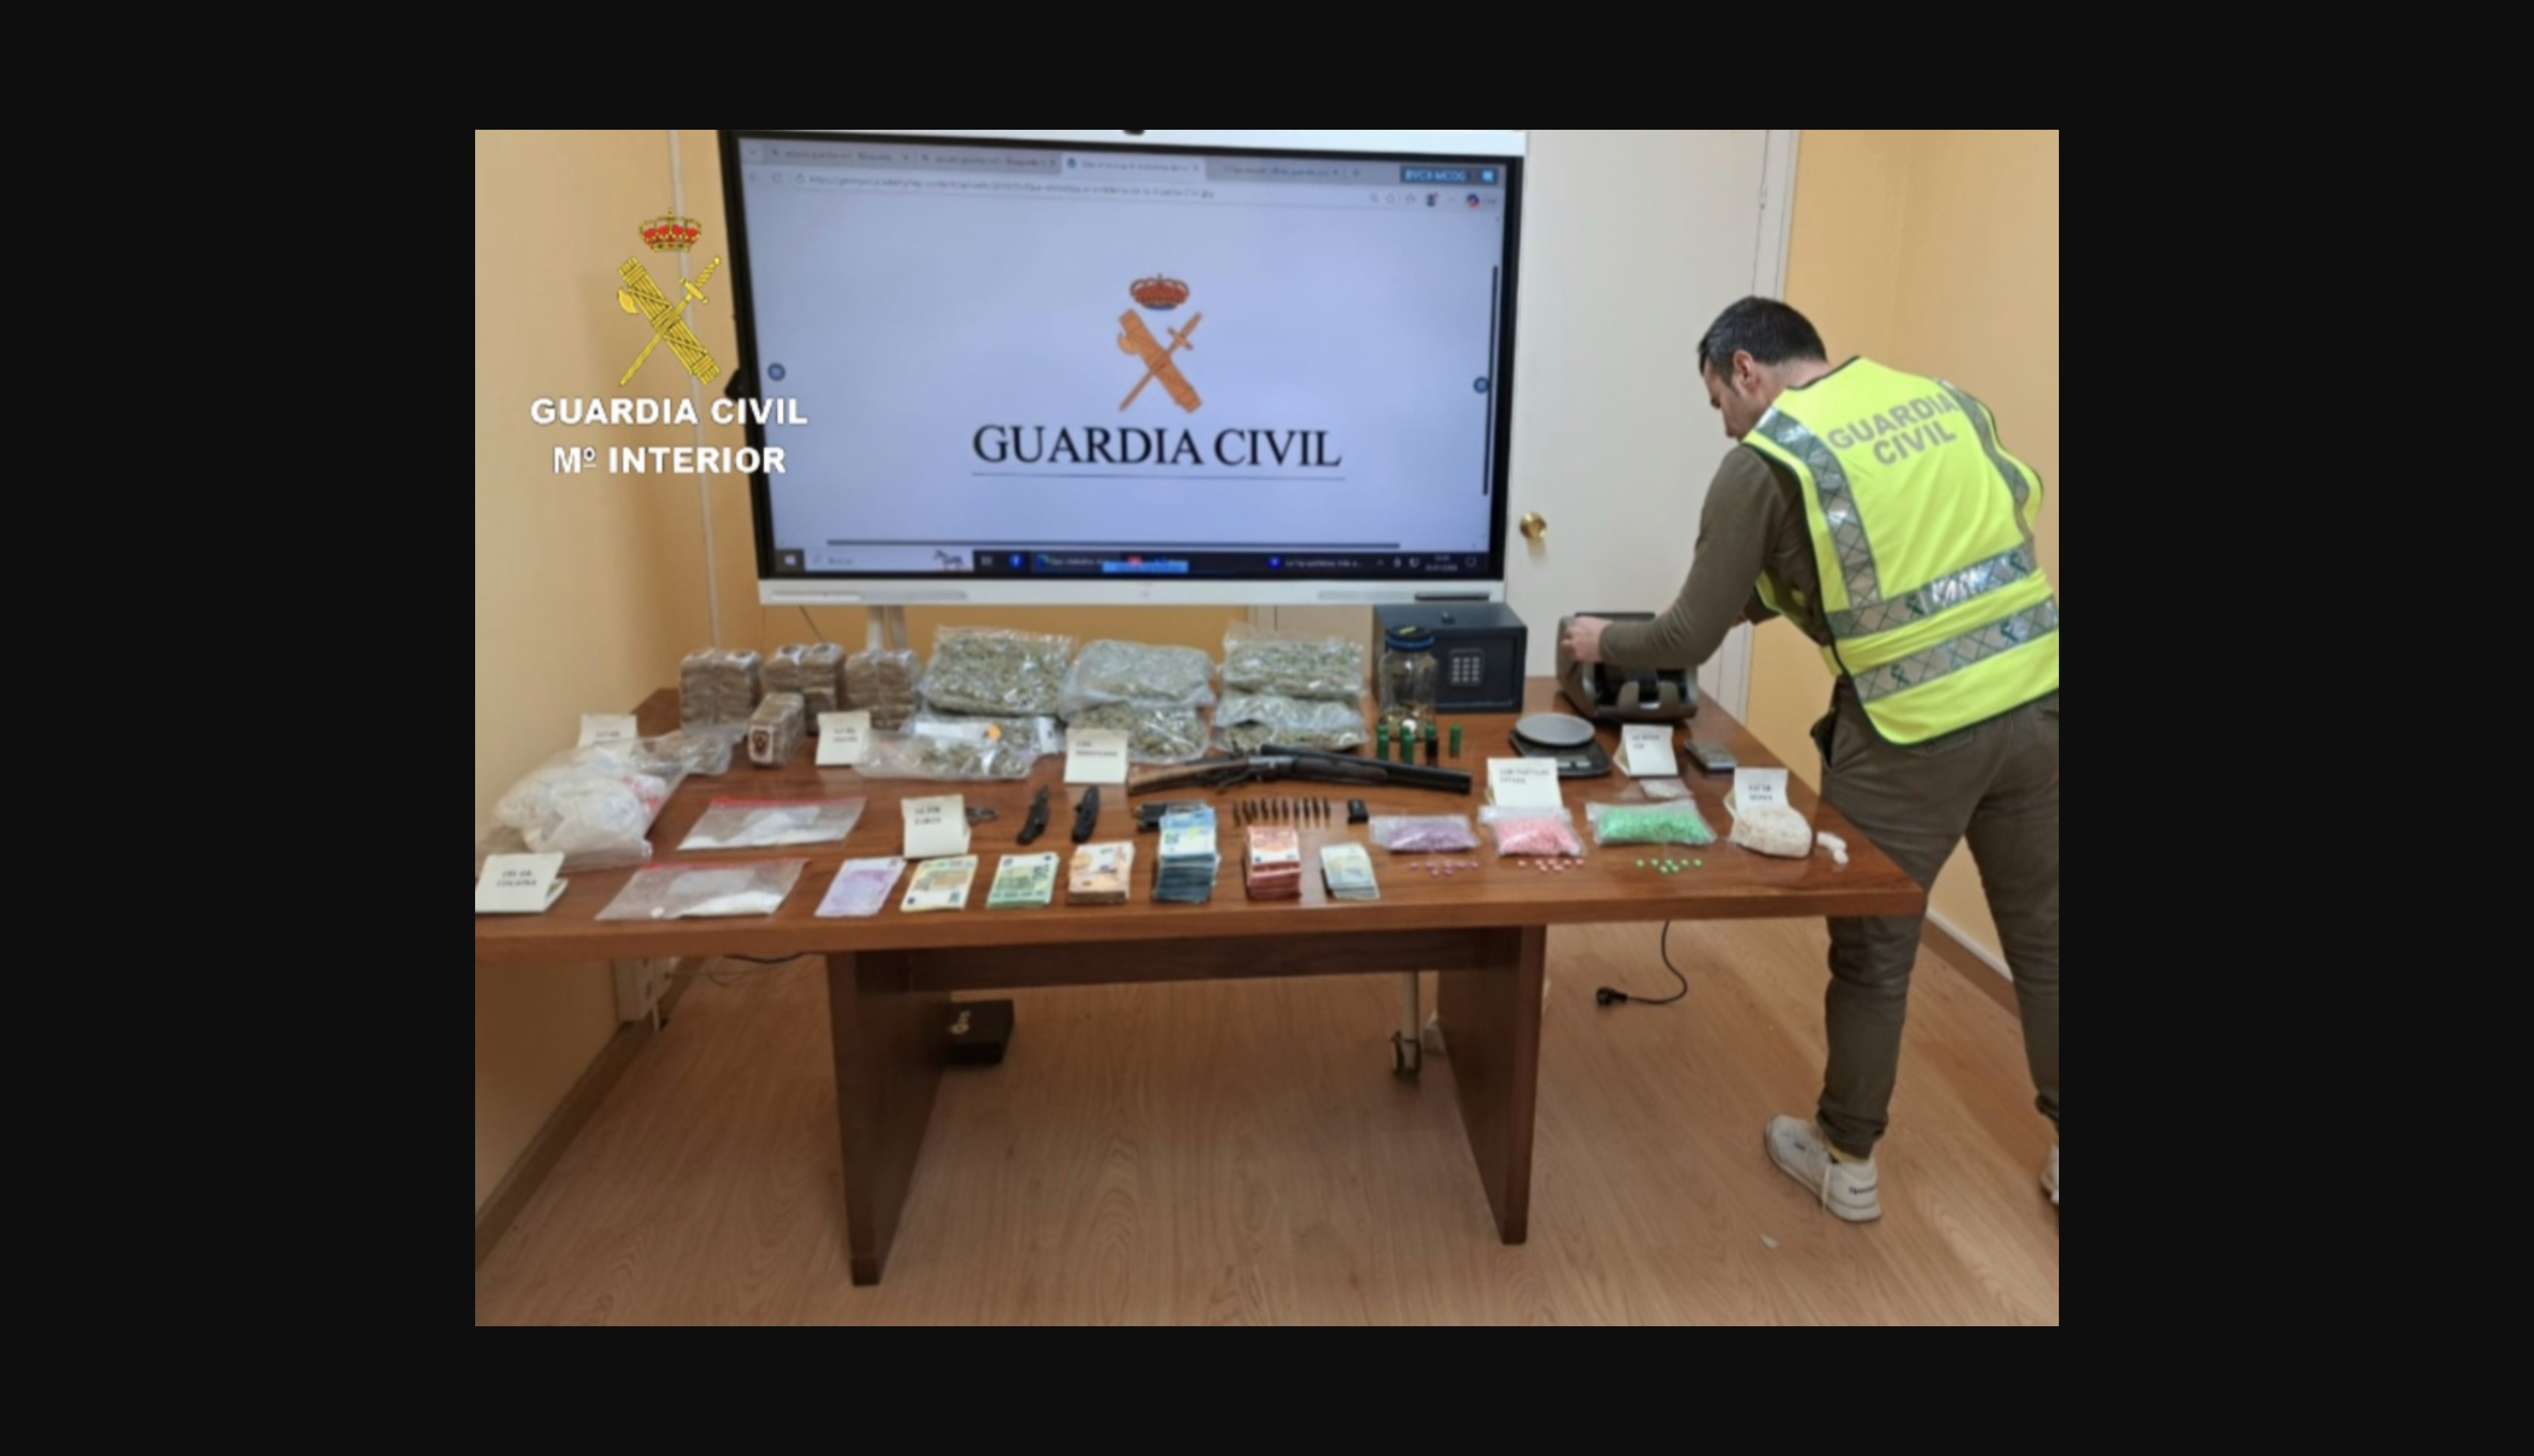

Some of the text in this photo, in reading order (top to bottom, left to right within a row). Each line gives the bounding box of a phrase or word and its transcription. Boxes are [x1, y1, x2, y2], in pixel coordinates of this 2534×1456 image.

[1827, 392, 1960, 449] GUARDIA
[1873, 420, 1957, 465] CIVIL
[973, 424, 1343, 467] GUARDIA CIVIL
